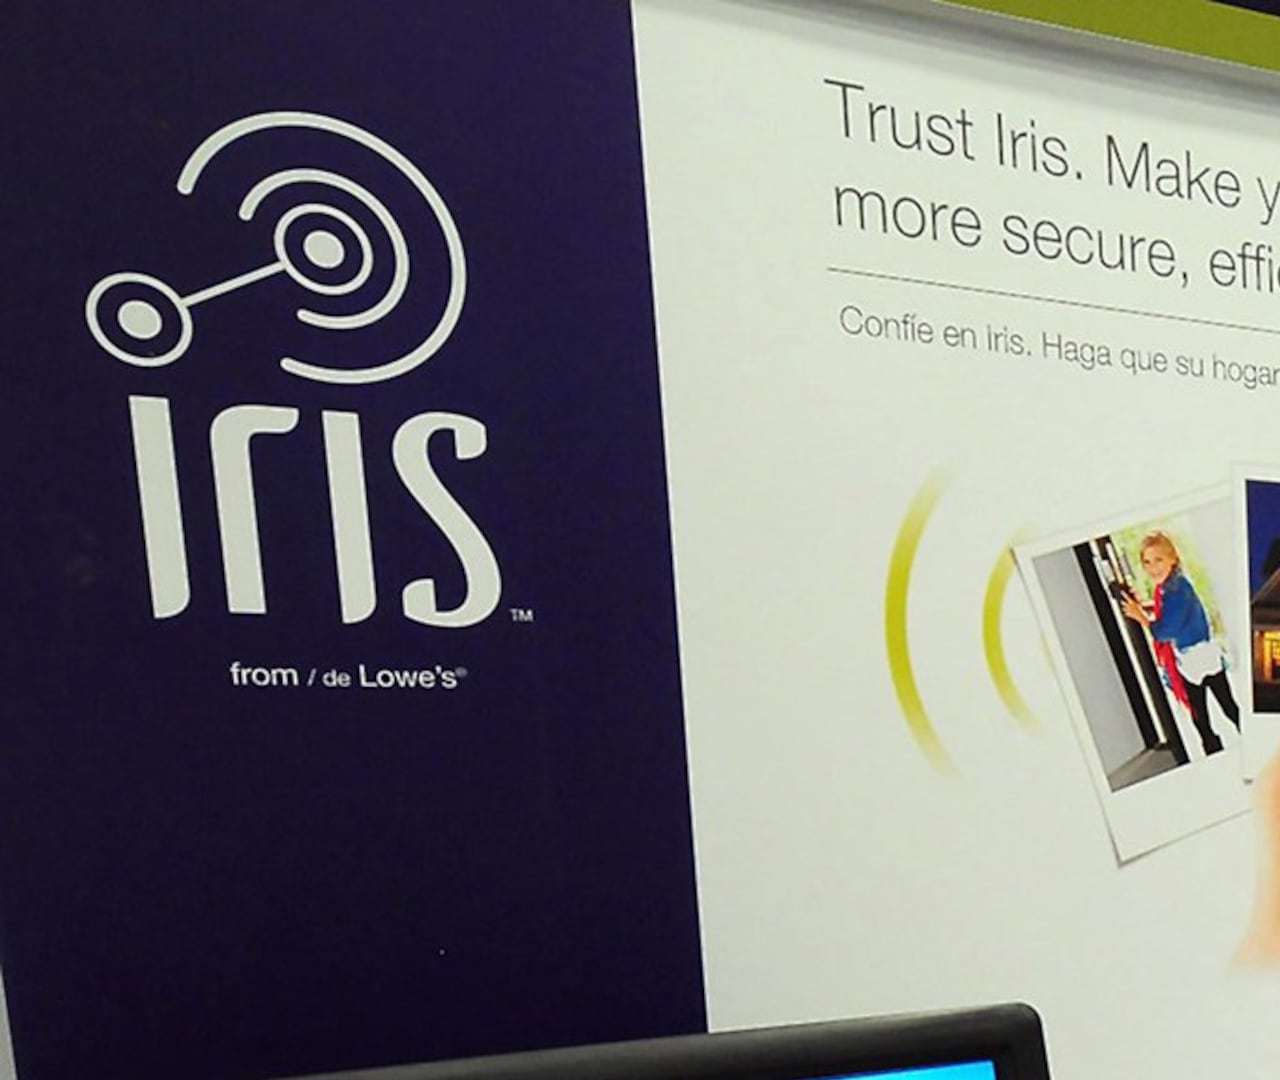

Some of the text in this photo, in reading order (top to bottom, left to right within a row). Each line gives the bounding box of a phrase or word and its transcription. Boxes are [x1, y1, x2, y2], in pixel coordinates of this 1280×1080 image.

[824, 79, 975, 161] Trust
[997, 113, 1082, 180] Iris.
[1107, 135, 1241, 208] Make
[835, 187, 982, 247] more
[1003, 215, 1188, 288] secure,
[840, 305, 938, 344] Confíe
[943, 325, 977, 349] en
[987, 325, 1031, 356] Iris.
[1042, 332, 1112, 371] Haga
[1120, 348, 1168, 375] que
[1175, 355, 1204, 377] su
[231, 661, 298, 687] from
[323, 667, 351, 687] de
